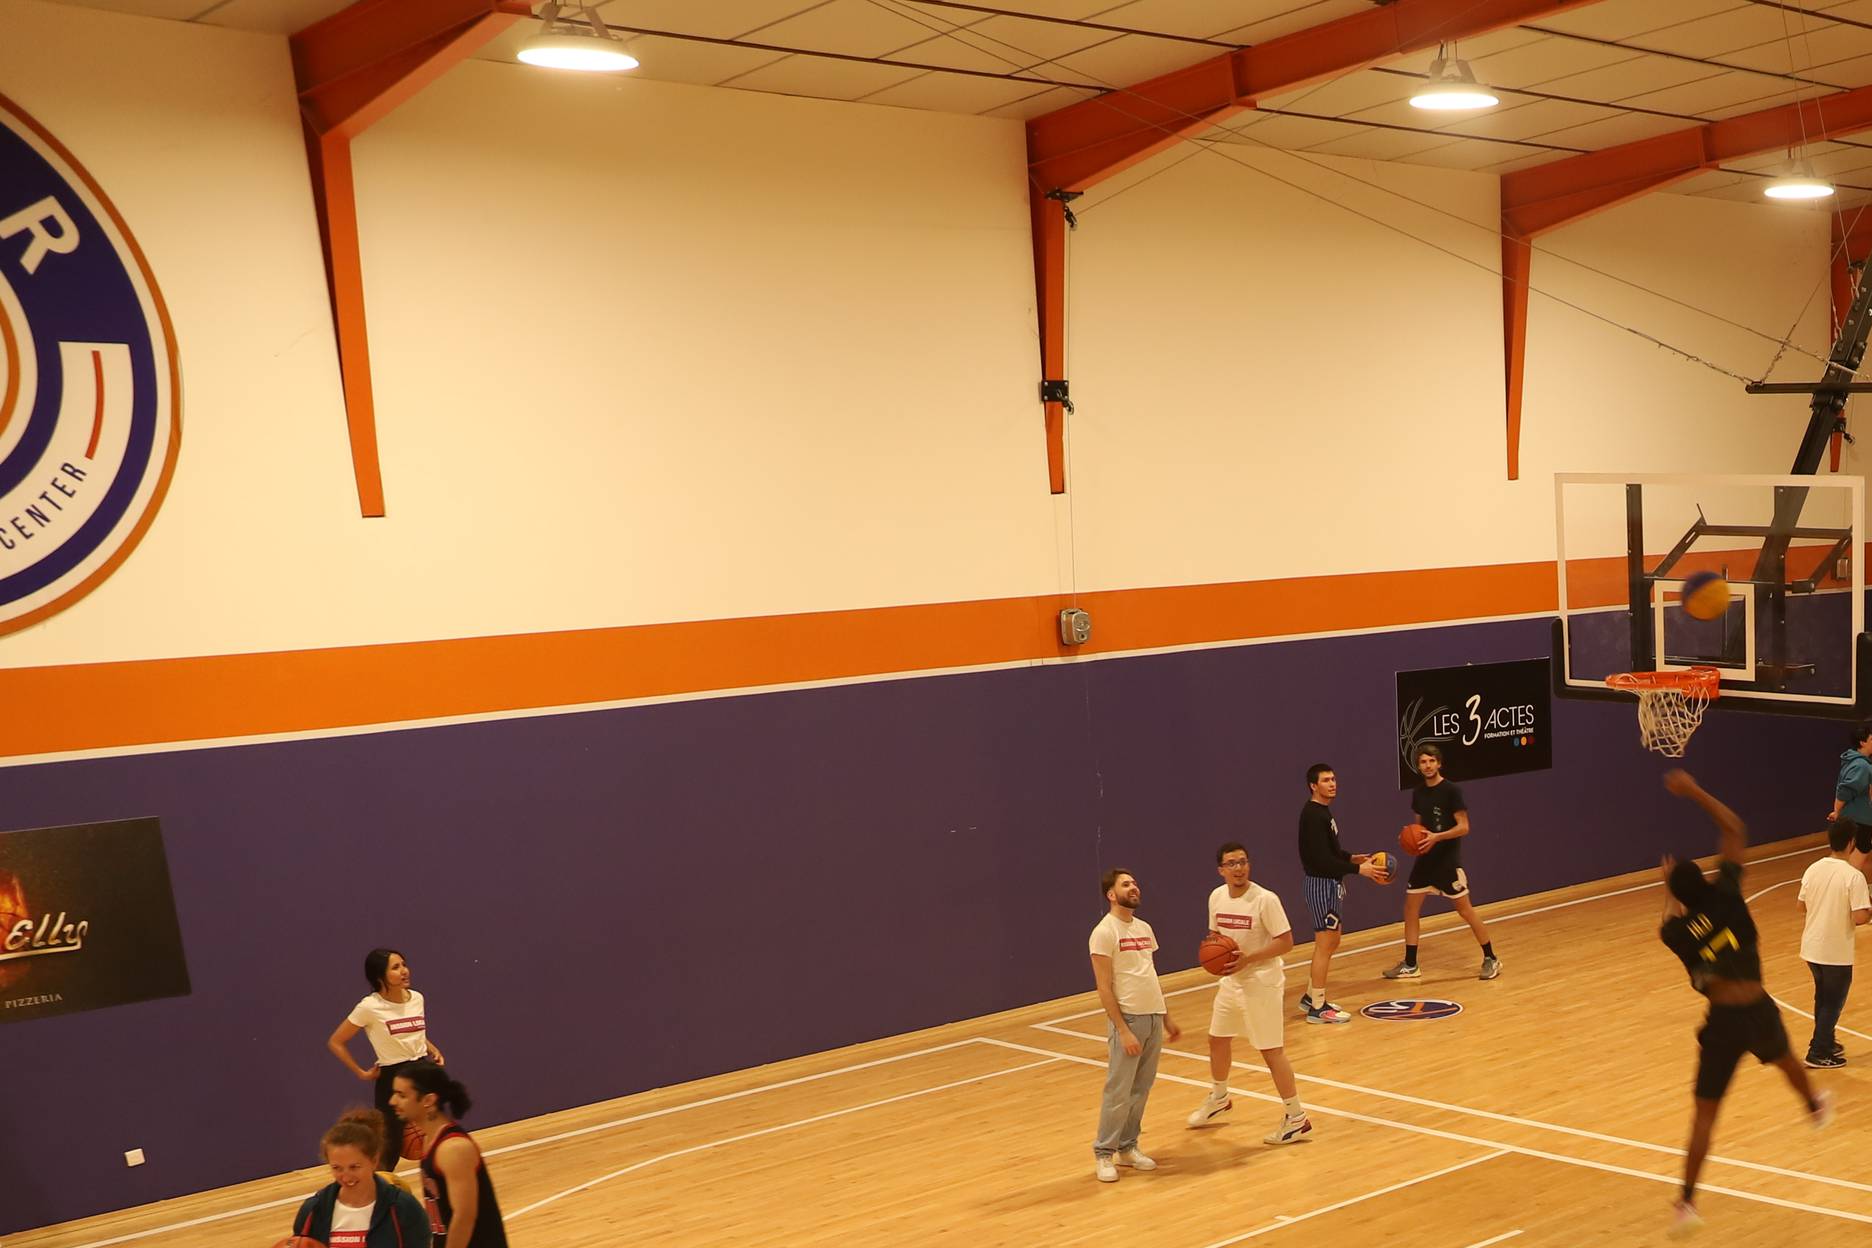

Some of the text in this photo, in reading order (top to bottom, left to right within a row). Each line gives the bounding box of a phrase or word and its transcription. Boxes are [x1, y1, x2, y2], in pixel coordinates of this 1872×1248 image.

[0, 461, 87, 551] CENTER
[1433, 694, 1535, 746] LES 3 ACTES
[4, 993, 64, 1008] PIZZERIA
